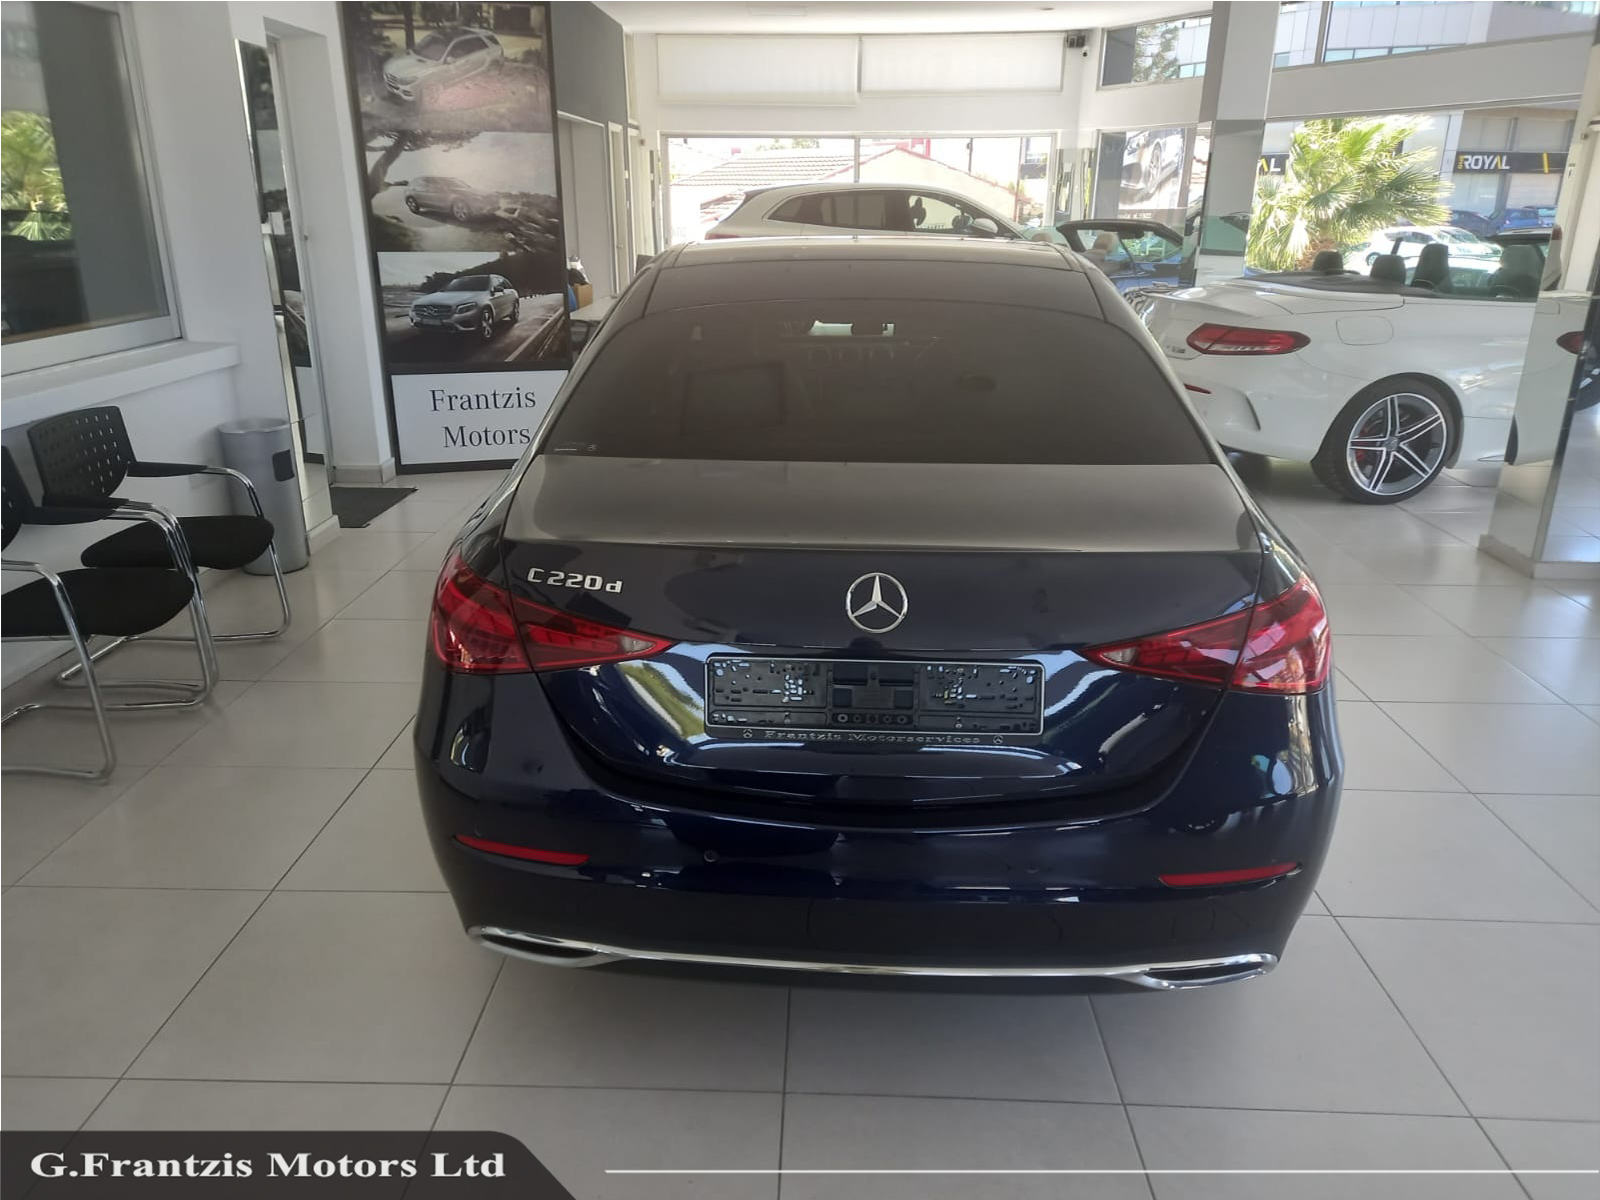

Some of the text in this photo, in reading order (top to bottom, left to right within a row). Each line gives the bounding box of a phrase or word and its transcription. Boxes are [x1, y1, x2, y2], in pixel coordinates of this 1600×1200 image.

[1463, 155, 1511, 170] ROYAL
[429, 387, 536, 412] Frantzis
[442, 425, 531, 448] Motors
[764, 730, 981, 744] Frantzis Motorservices
